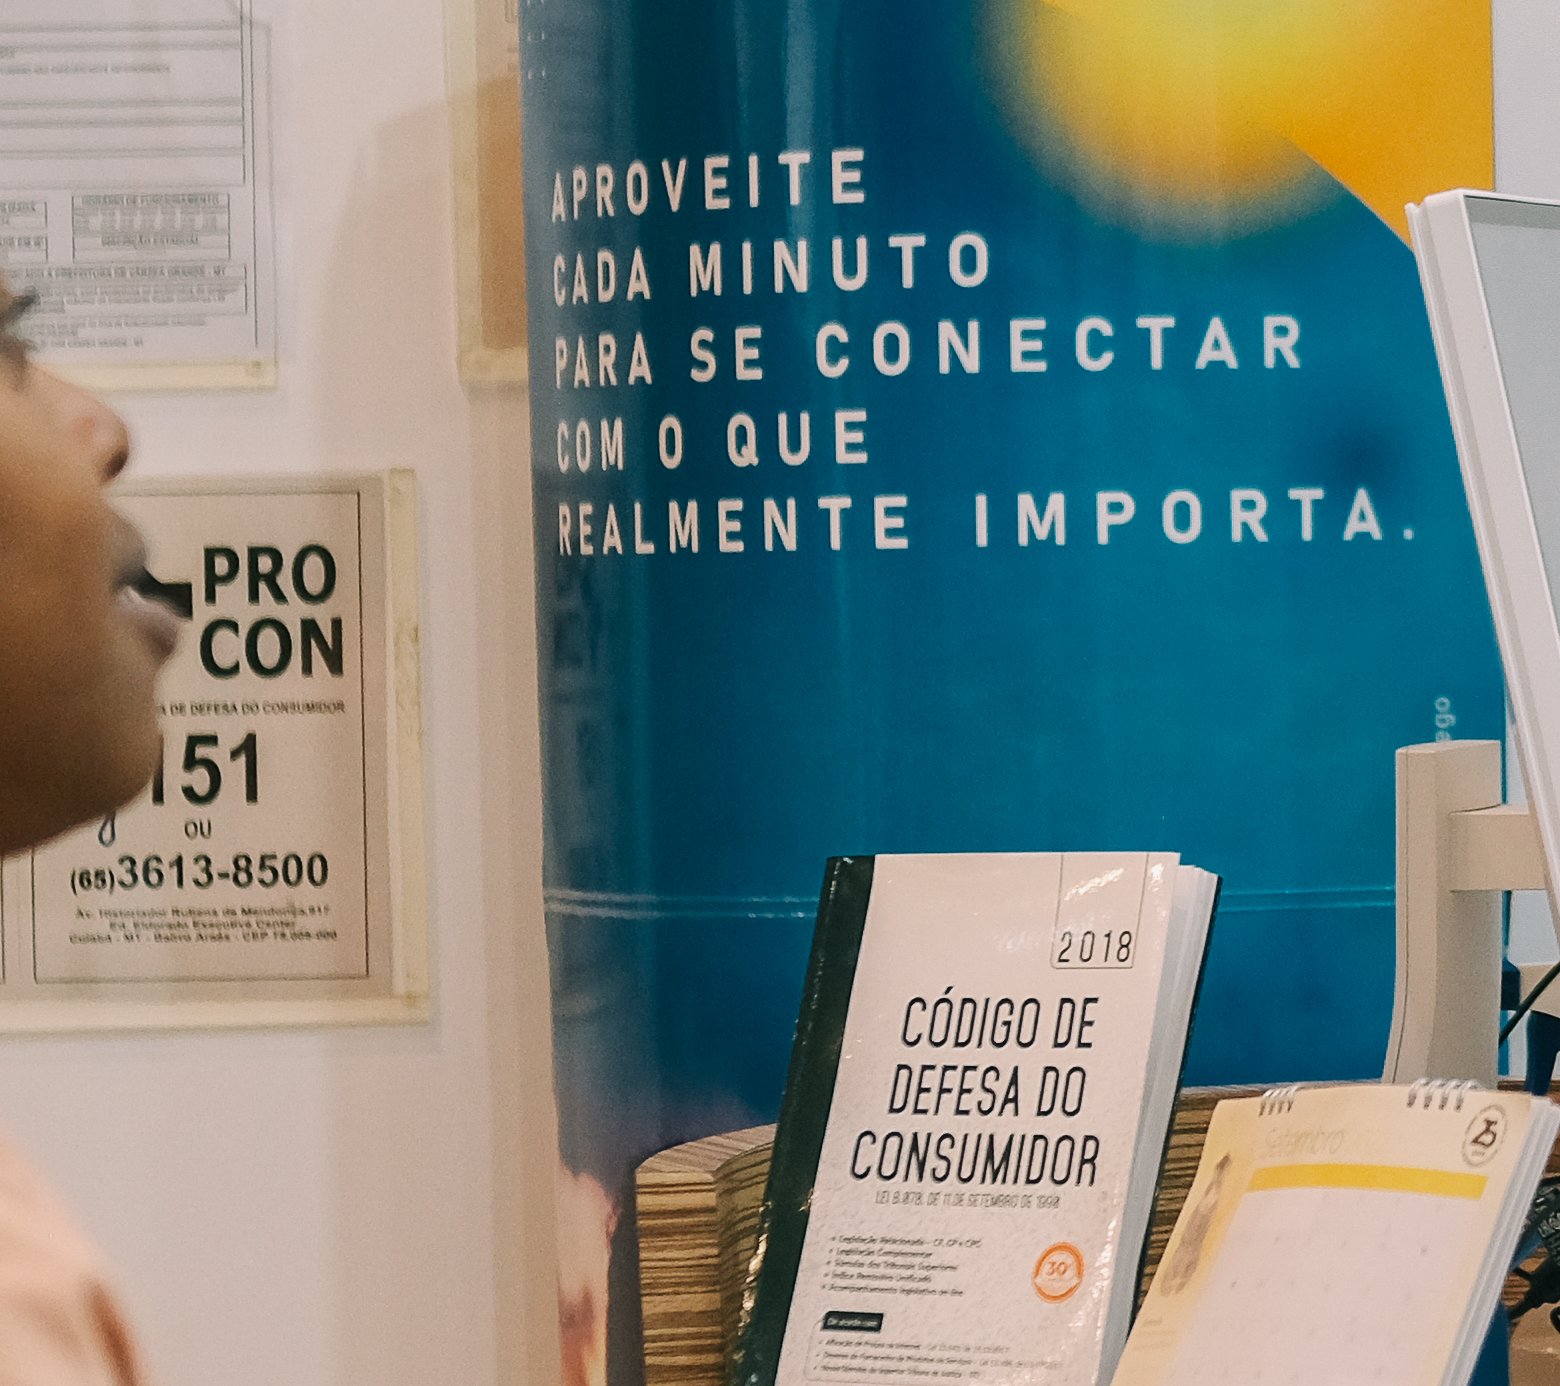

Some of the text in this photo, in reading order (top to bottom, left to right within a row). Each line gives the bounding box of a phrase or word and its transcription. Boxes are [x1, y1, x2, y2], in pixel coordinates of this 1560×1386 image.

[551, 147, 867, 222] APROVEITE
[551, 231, 992, 308] CADA MINUTO
[554, 315, 1304, 390] PARA SE CONECTAR
[555, 408, 870, 474] COM O QUE
[557, 487, 1416, 557] REALMENTE IMPORTA.
[203, 544, 337, 606] PRO
[198, 616, 344, 679] CON
[184, 818, 212, 840] OU
[1057, 929, 1133, 964] 2018
[901, 986, 1099, 1049] CÓDIGO DE
[888, 1064, 1087, 1118] DEFESA DO
[849, 1129, 1101, 1188] CONSUMIDOR
